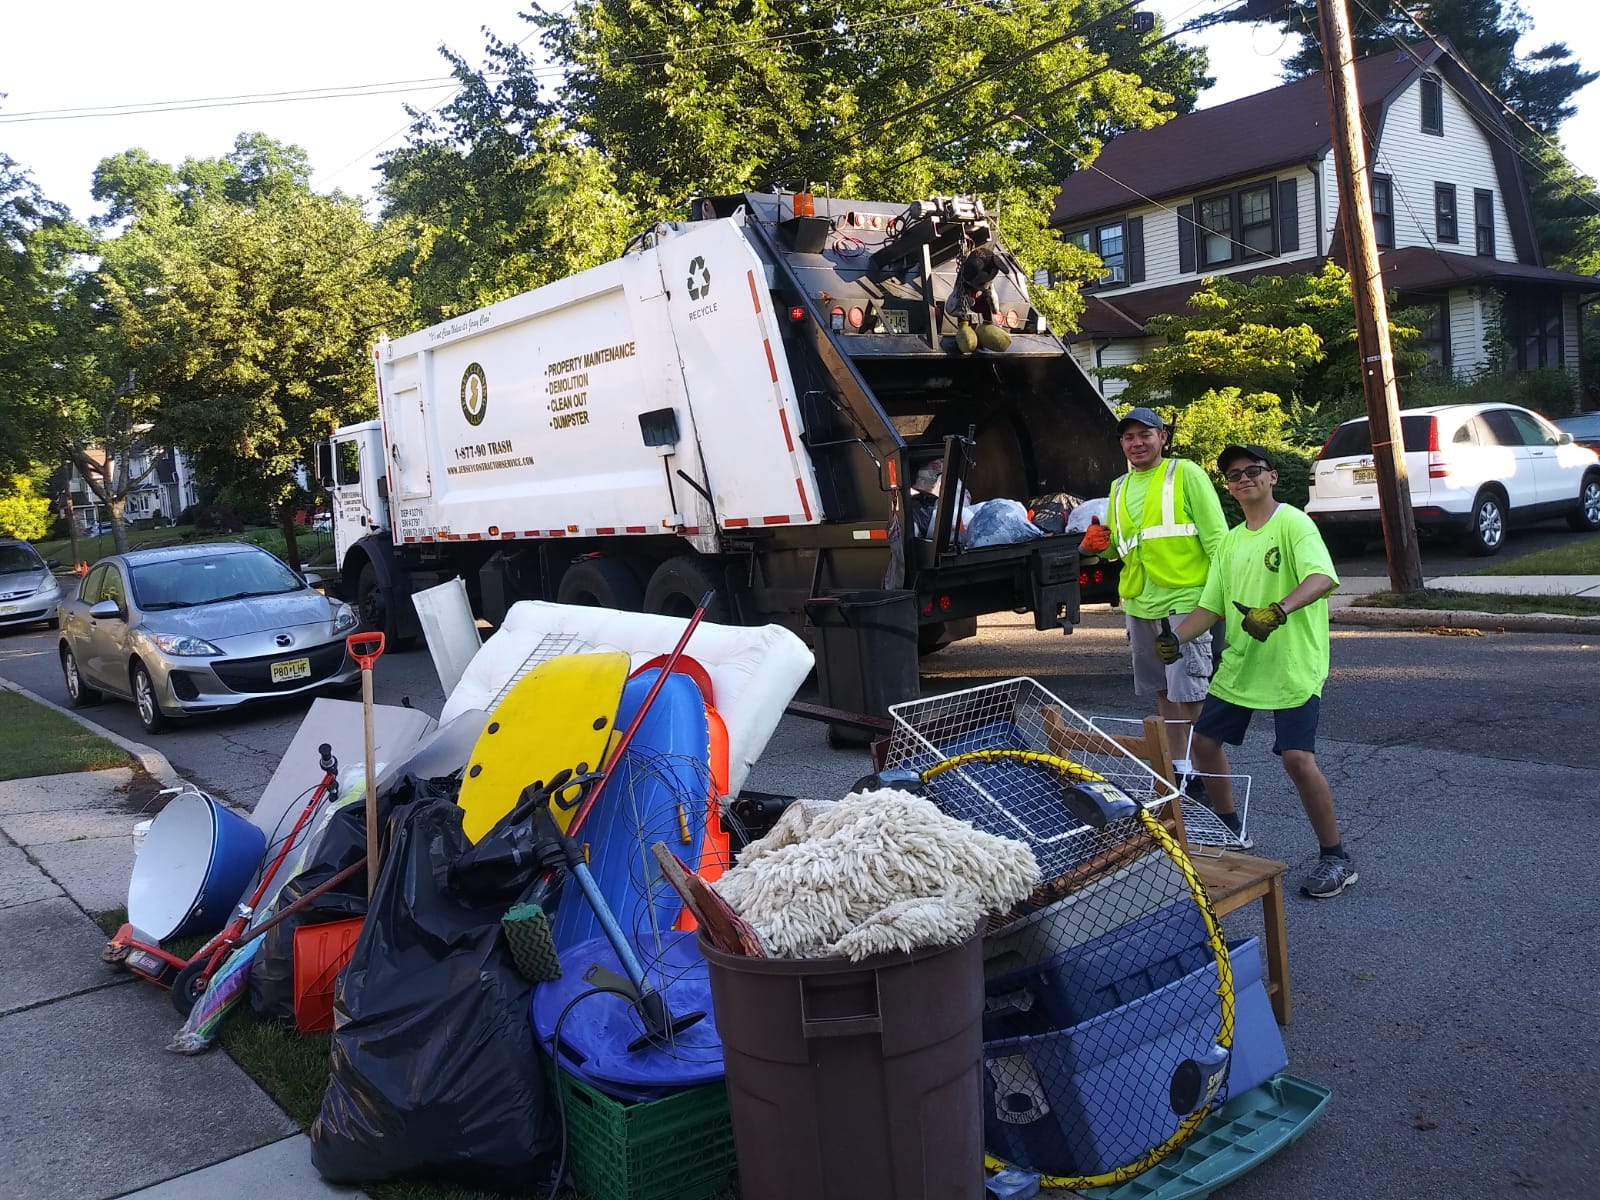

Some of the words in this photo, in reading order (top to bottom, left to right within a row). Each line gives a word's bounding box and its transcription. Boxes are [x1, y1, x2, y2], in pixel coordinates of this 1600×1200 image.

[689, 302, 718, 321] RECYCLE
[548, 355, 582, 377] PROPERTY
[584, 341, 635, 368] MAINTENANCE
[549, 372, 588, 395] DEMOLITION
[551, 395, 572, 412] CLEAN
[573, 392, 587, 407] OUT
[553, 410, 589, 429] DUMPSTER
[455, 444, 486, 460] 1-877-90
[487, 440, 512, 455] TRASH
